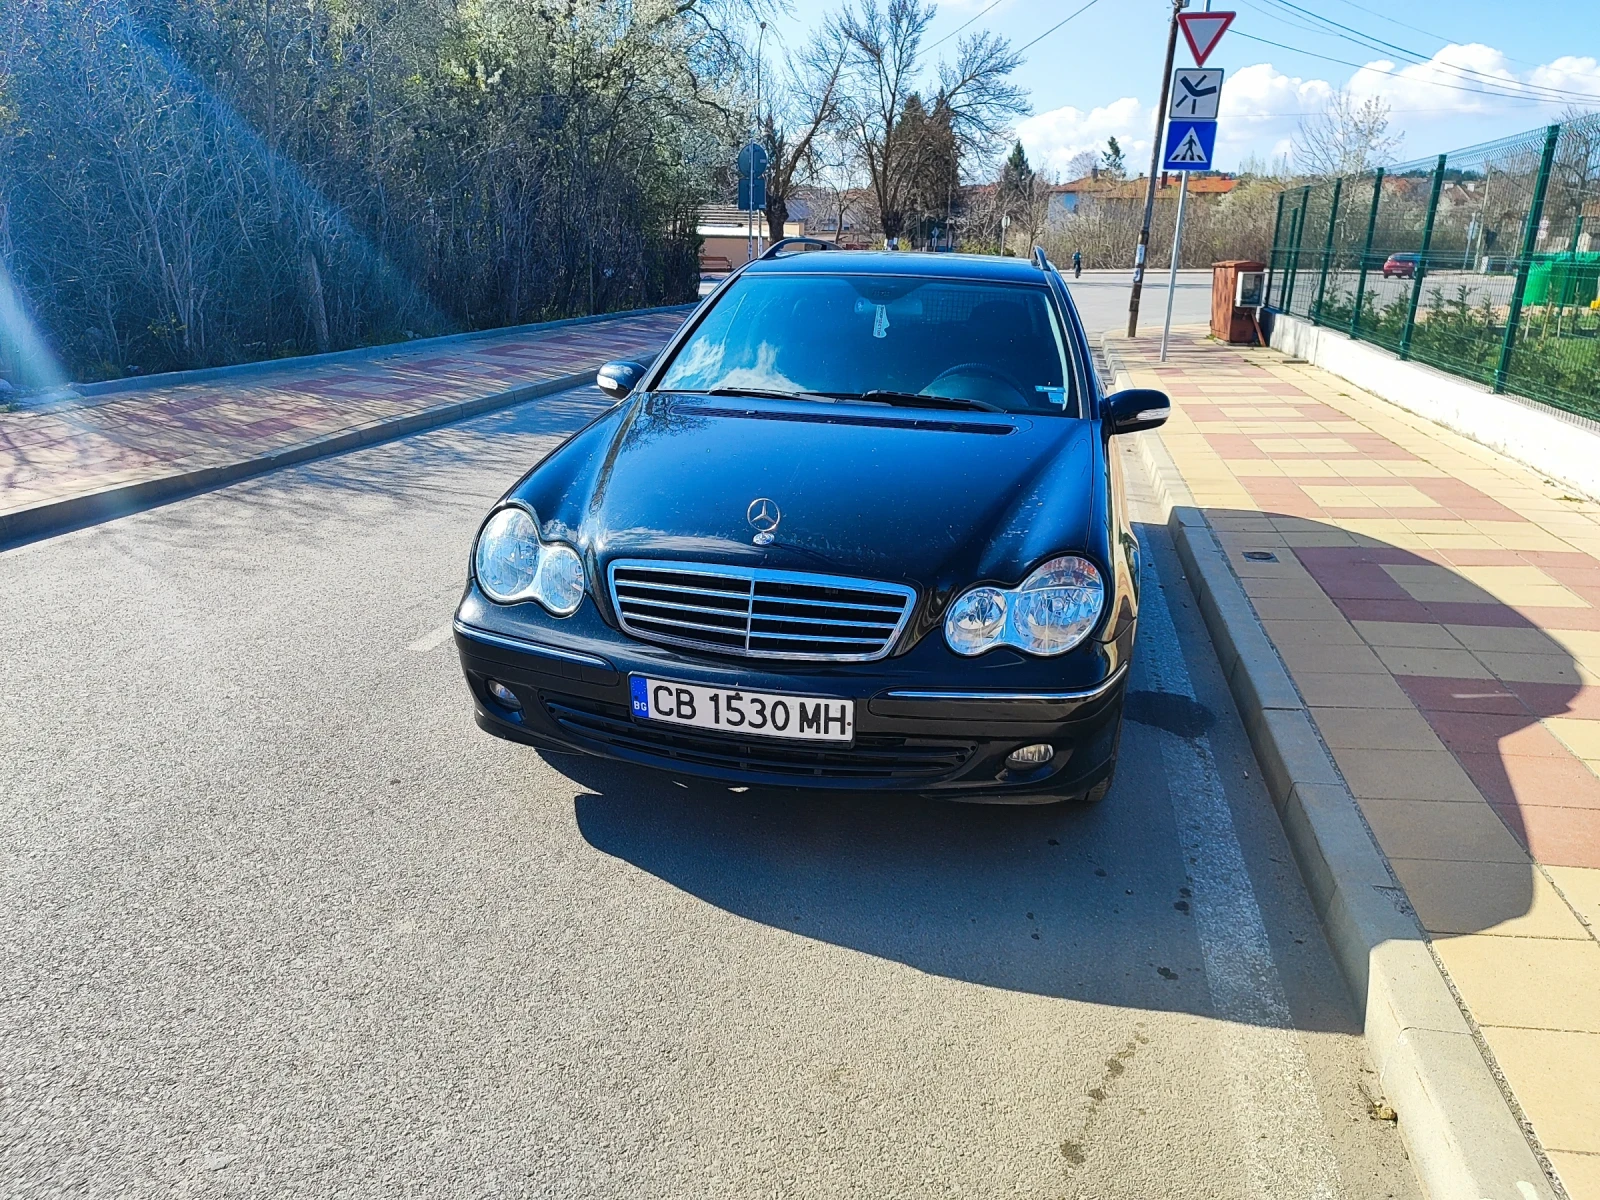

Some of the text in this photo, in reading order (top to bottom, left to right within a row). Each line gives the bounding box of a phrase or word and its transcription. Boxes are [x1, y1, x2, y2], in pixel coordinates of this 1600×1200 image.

[633, 700, 647, 711] BG
[653, 685, 846, 735] CB 1530 MH
